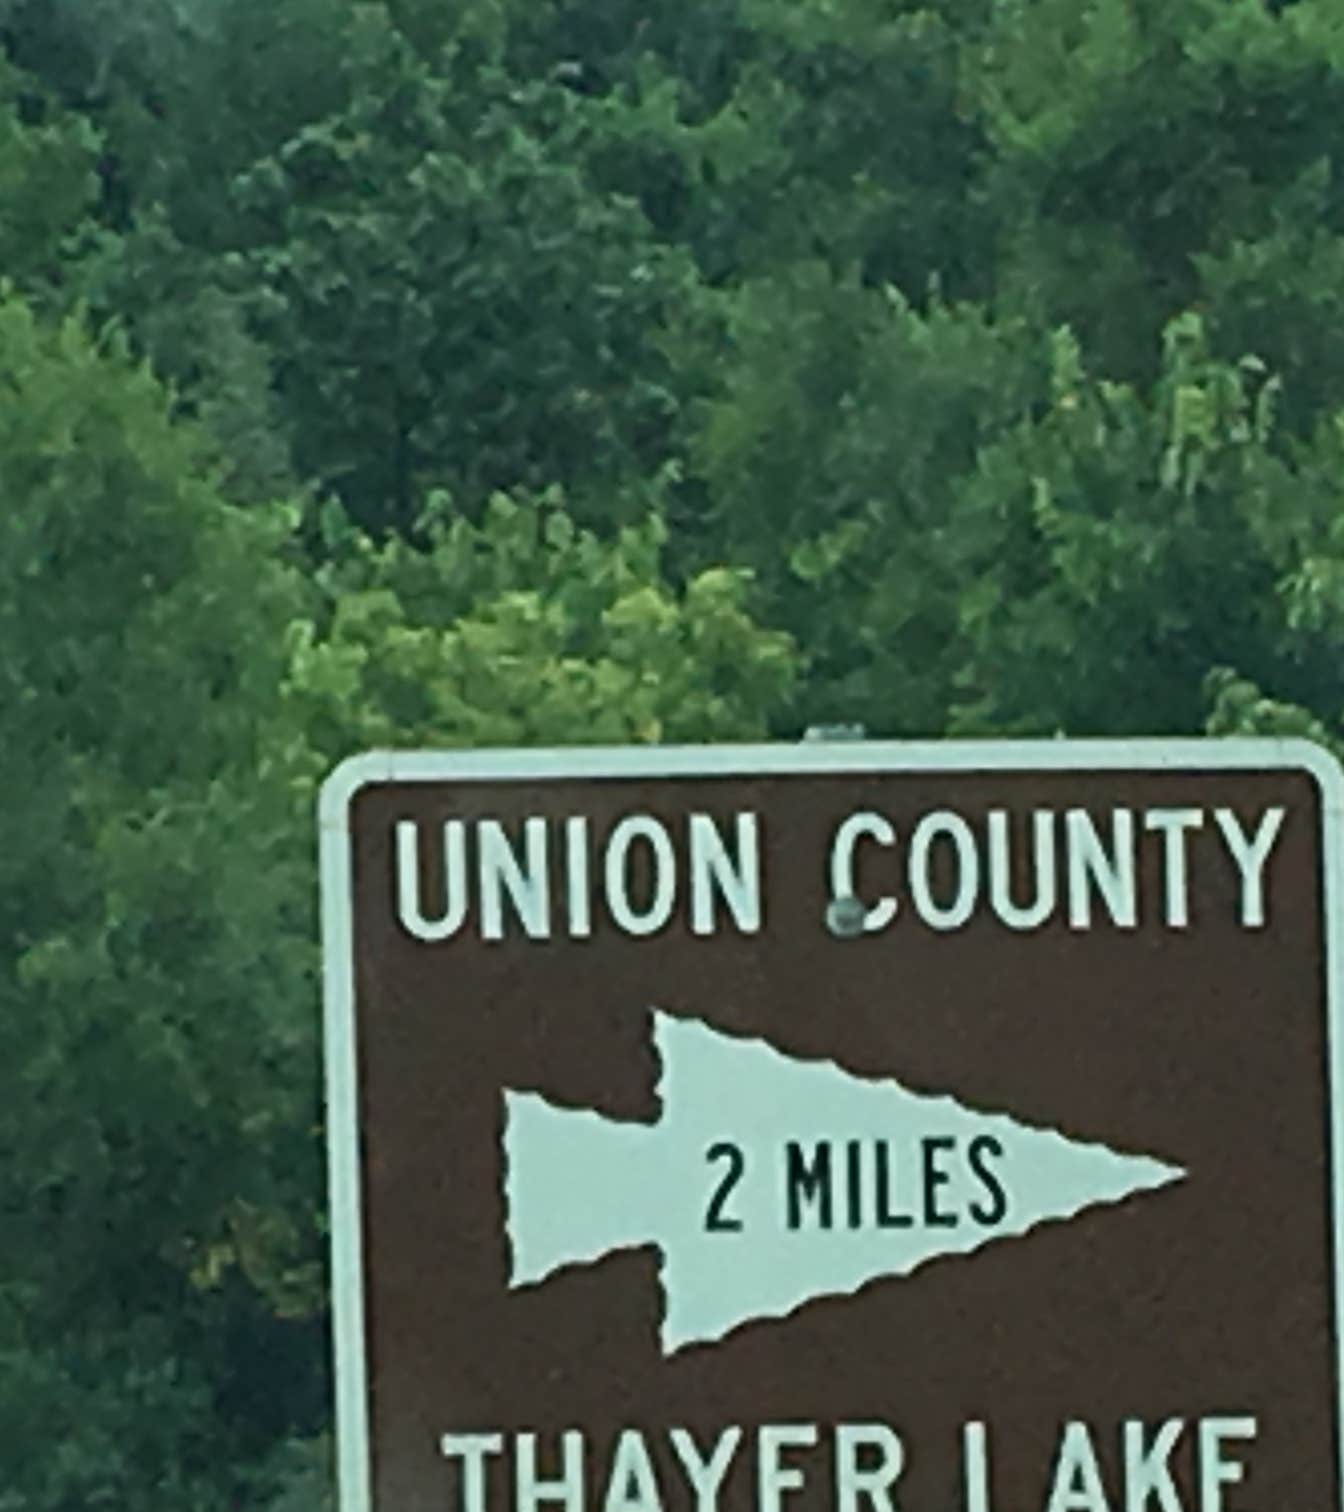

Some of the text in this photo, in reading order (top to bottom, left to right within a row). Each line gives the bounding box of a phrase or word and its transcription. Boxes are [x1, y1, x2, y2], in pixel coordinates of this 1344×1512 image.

[397, 808, 1284, 940] UNION COUNTY
[705, 1136, 1008, 1232] 2 MILES
